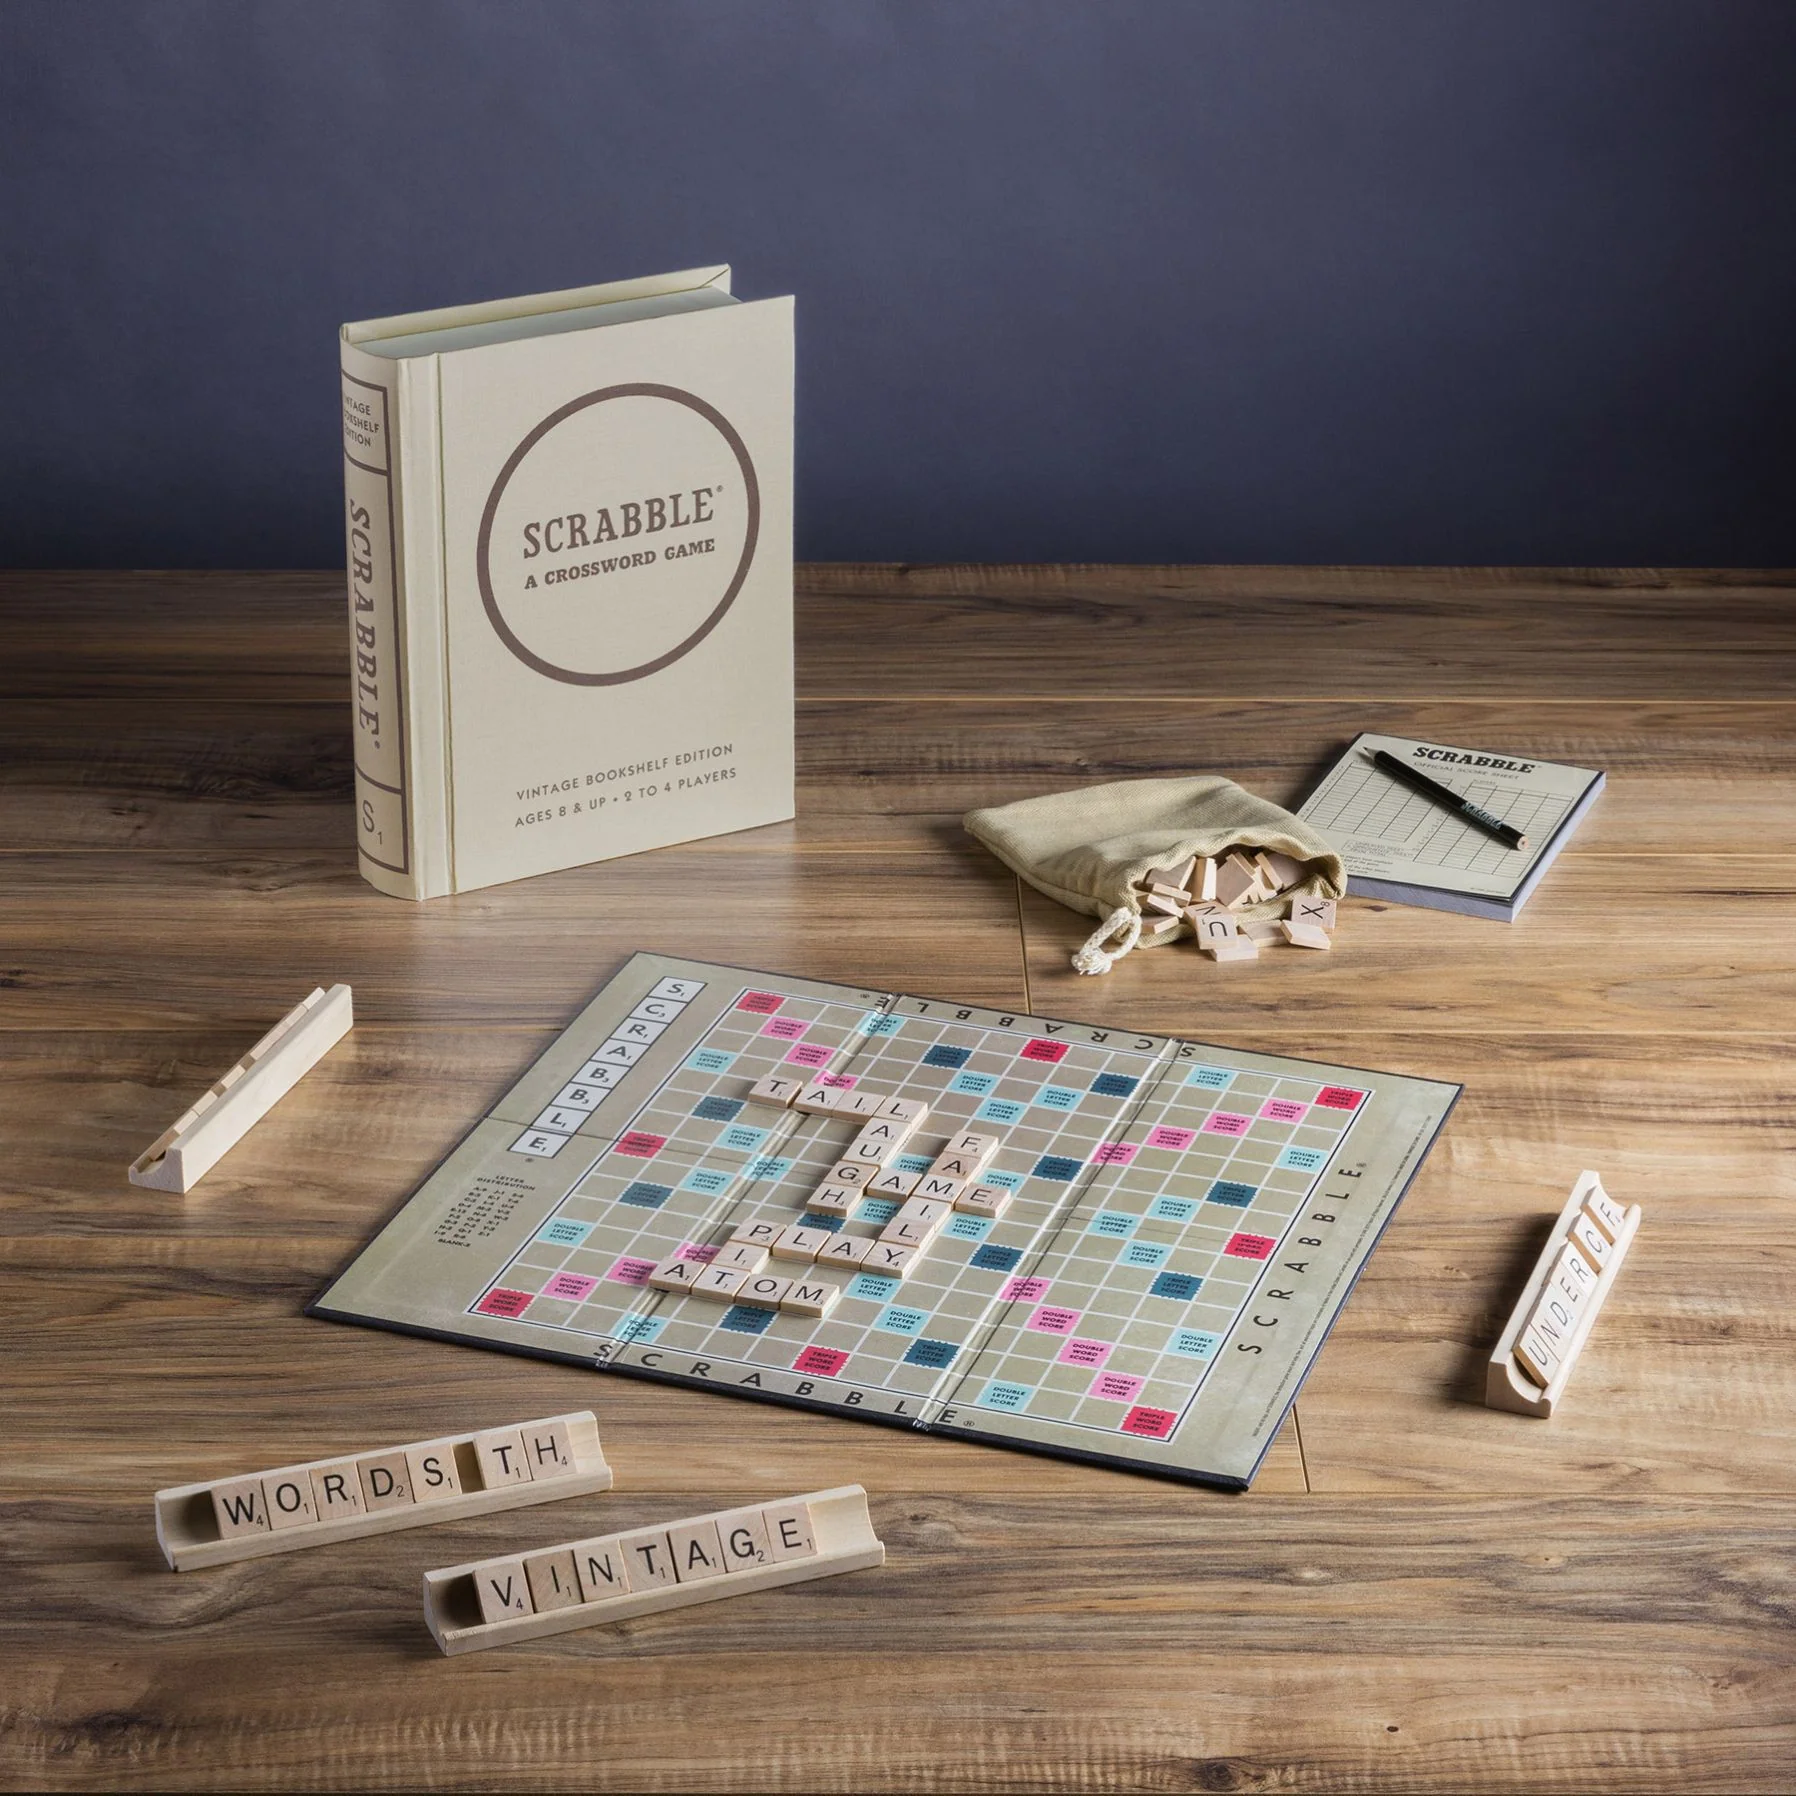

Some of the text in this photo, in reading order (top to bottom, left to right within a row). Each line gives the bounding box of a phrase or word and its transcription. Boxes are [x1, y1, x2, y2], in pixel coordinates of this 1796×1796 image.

[524, 538, 715, 590] A CROSSWORD GAME
[516, 743, 733, 801] VINTAGE BOOKSHELF EDITION
[515, 767, 737, 828] AGES 8 & UP 2 TO 4 PLAYERS
[1161, 1199, 1191, 1208] DOUBLE
[955, 1218, 986, 1226] DOUBLE
[1102, 1215, 1133, 1223] DOUBLE
[553, 1223, 584, 1231] DOUBLE
[1132, 1245, 1163, 1254] DOUBLE
[559, 1277, 590, 1286] DOUBLE
[861, 1278, 893, 1286] DOUBLE
[860, 1283, 887, 1291] LETTER
[858, 1288, 883, 1296] SCORE
[889, 1310, 921, 1319] DOUBLE
[1041, 1310, 1073, 1319] DOUBLE
[888, 1316, 916, 1324] LETTER
[886, 1321, 911, 1329] SCORE
[1039, 1321, 1064, 1329] SCORE
[1180, 1334, 1213, 1343] DOUBLE
[1072, 1342, 1104, 1352] DOUBLE
[1179, 1339, 1208, 1348] LETTER
[1072, 1348, 1098, 1356] WORD
[1178, 1344, 1204, 1353] SCORE
[1069, 1354, 1095, 1362] SCORE
[1103, 1376, 1136, 1386] DOUBLE
[992, 1386, 1026, 1395] DOUBLE
[1104, 1382, 1130, 1390] WORD
[991, 1392, 1020, 1400] LETTER
[1101, 1388, 1126, 1396] SCORE
[989, 1397, 1016, 1406] SCORE
